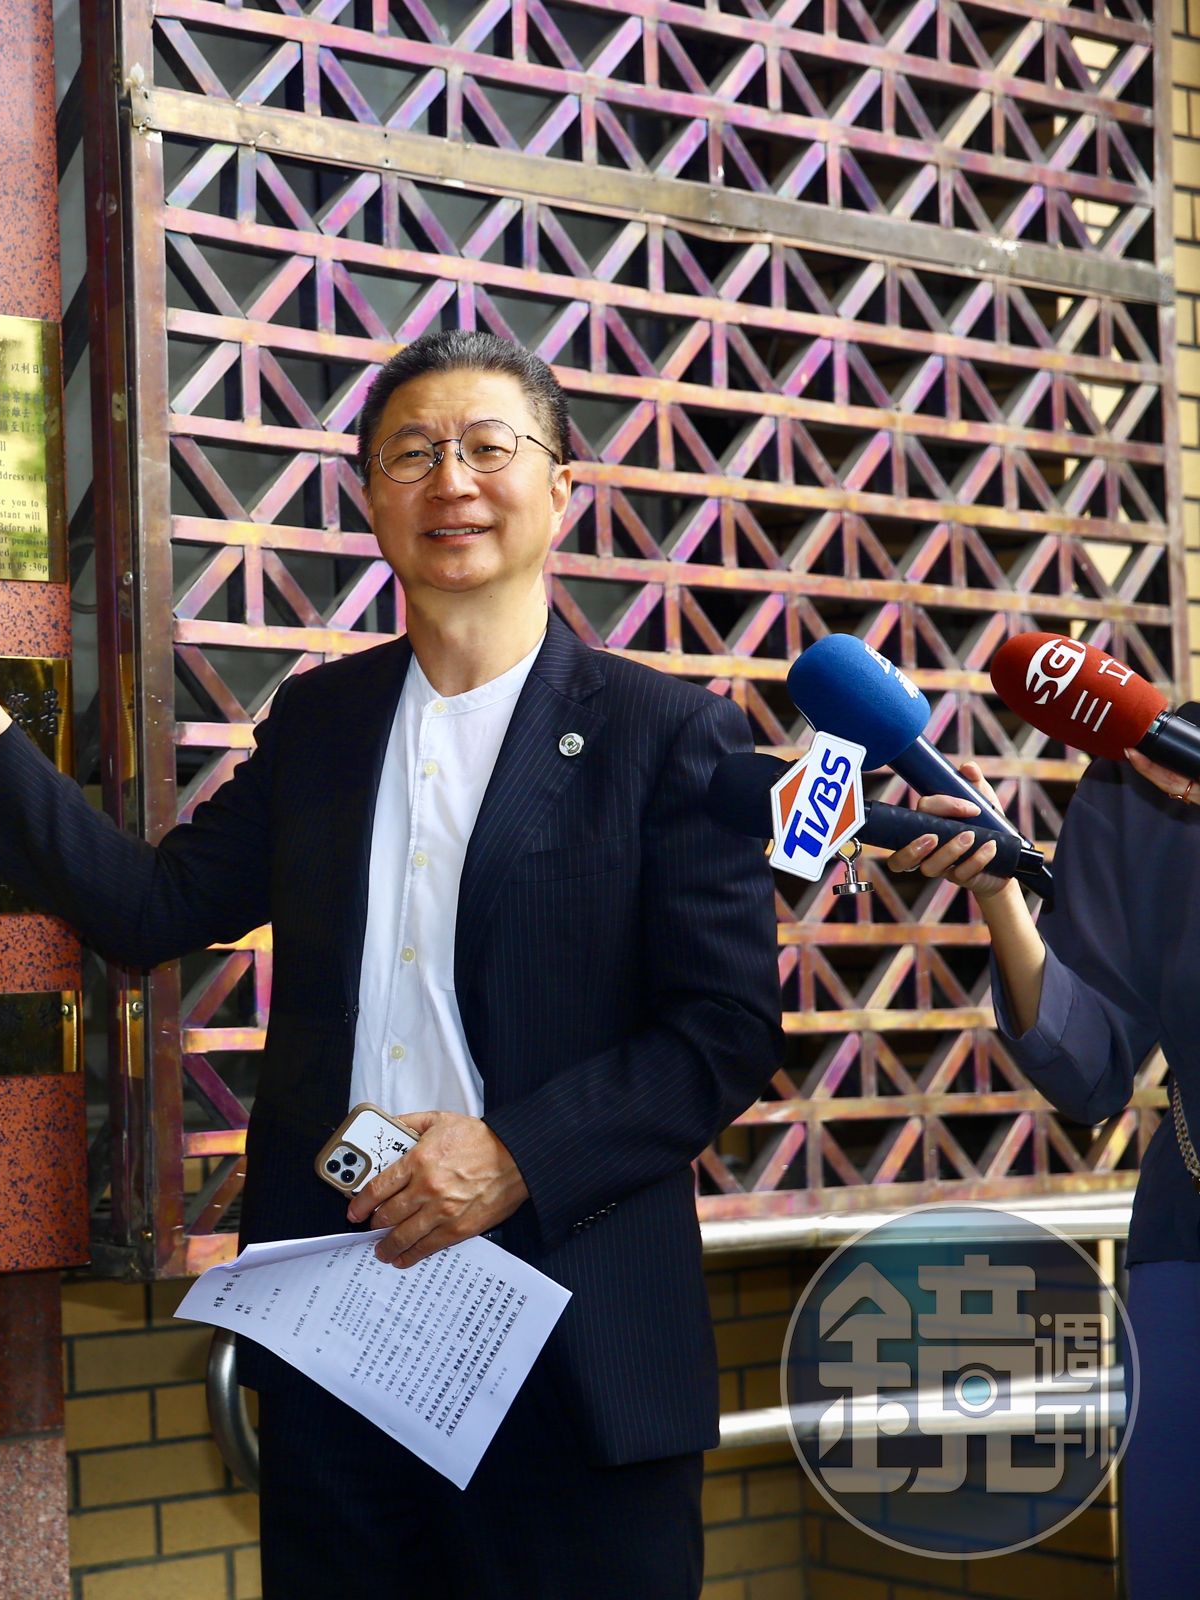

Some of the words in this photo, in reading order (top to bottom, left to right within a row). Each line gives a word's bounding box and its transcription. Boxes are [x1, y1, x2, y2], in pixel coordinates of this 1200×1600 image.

[12, 500, 27, 508] you
[25, 512, 40, 521] will
[30, 525, 41, 533] the
[1070, 658, 1134, 733] 三立
[783, 748, 851, 858] TVBS
